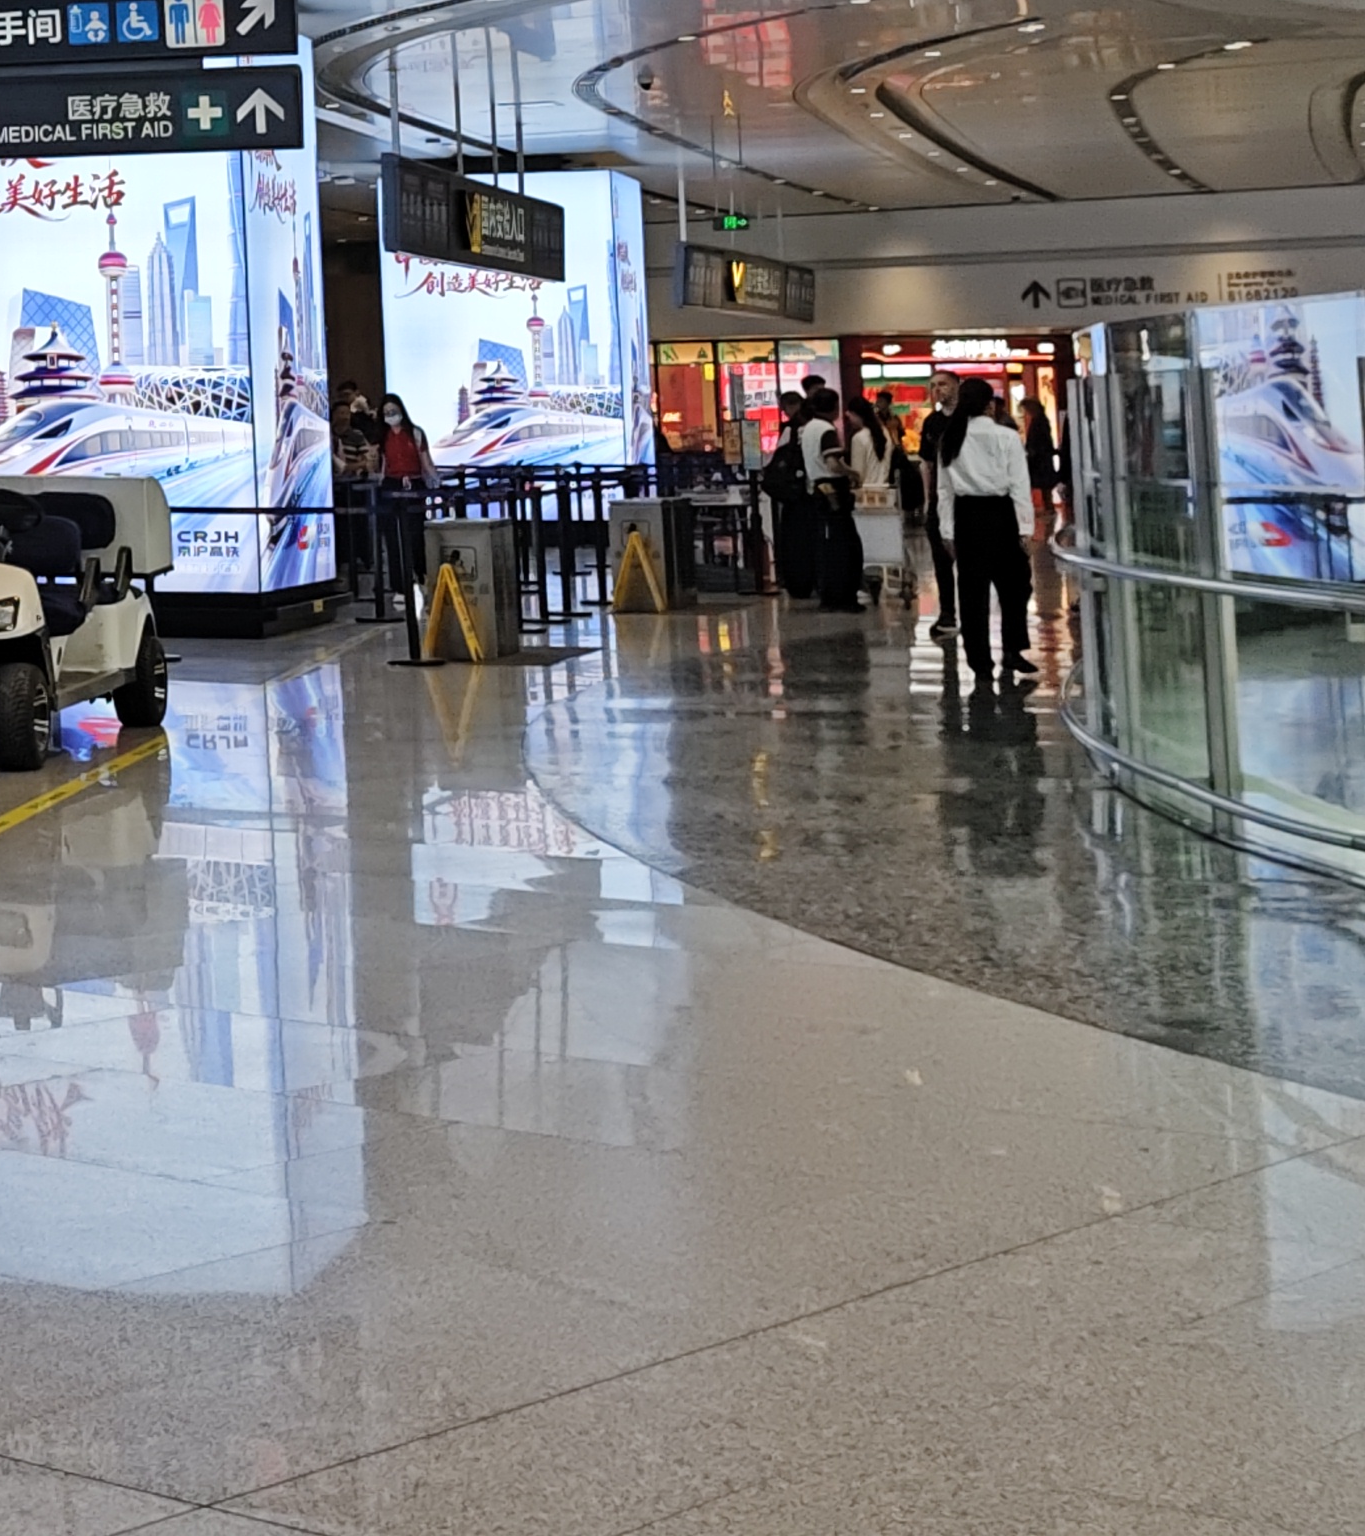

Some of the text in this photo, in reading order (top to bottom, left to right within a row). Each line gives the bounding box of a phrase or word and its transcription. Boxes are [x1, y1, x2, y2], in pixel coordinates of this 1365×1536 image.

[67, 92, 172, 121] 医疗急救
[81, 121, 136, 141] FIRST
[141, 120, 173, 138] AID
[1145, 292, 1180, 305] FIRST
[1186, 291, 1209, 304] AID
[177, 530, 239, 543] CRJH
